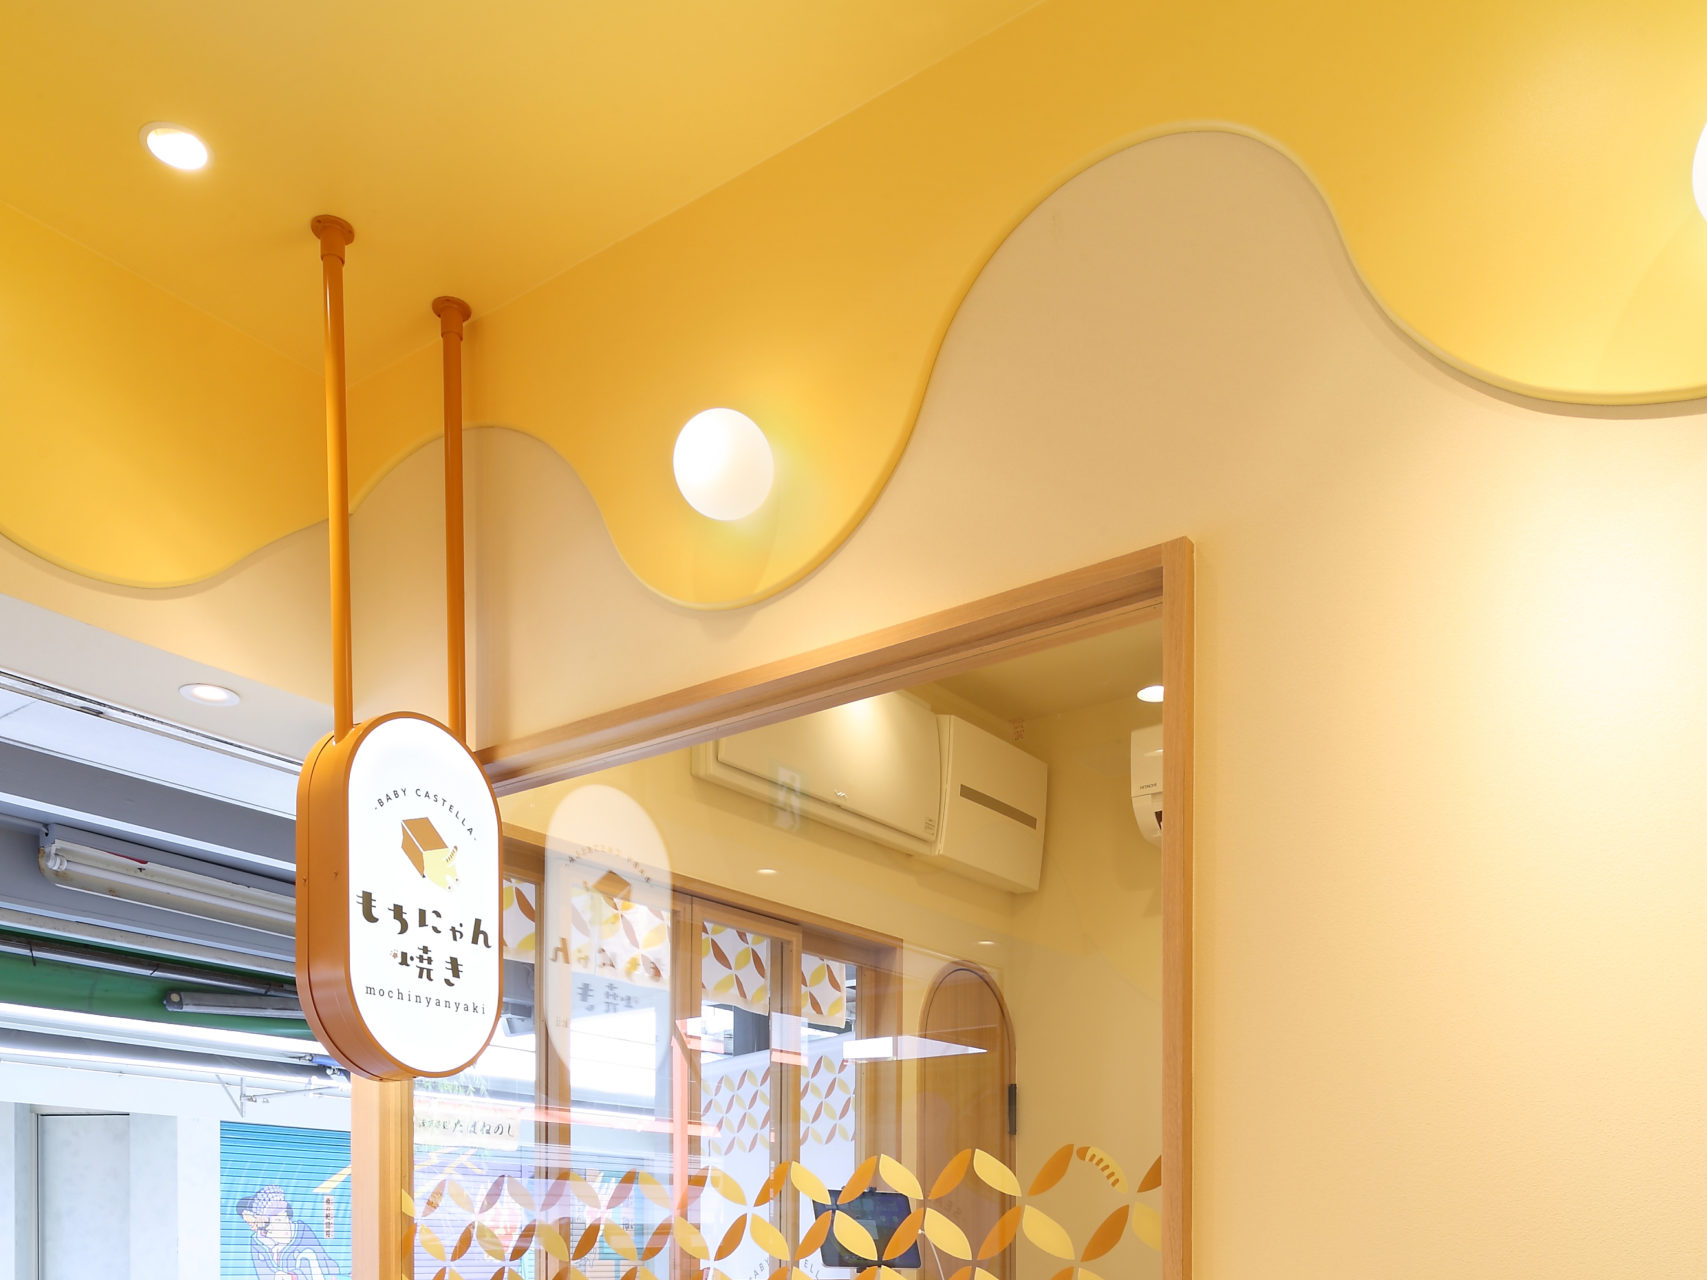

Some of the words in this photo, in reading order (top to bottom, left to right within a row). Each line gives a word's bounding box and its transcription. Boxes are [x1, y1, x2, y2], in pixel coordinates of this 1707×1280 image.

[377, 787, 407, 808] BABY
[415, 788, 473, 836] CASTELLA
[356, 890, 492, 949] もちにゃん
[398, 945, 463, 987] 焼き
[365, 985, 486, 1015] mochinyanyaki
